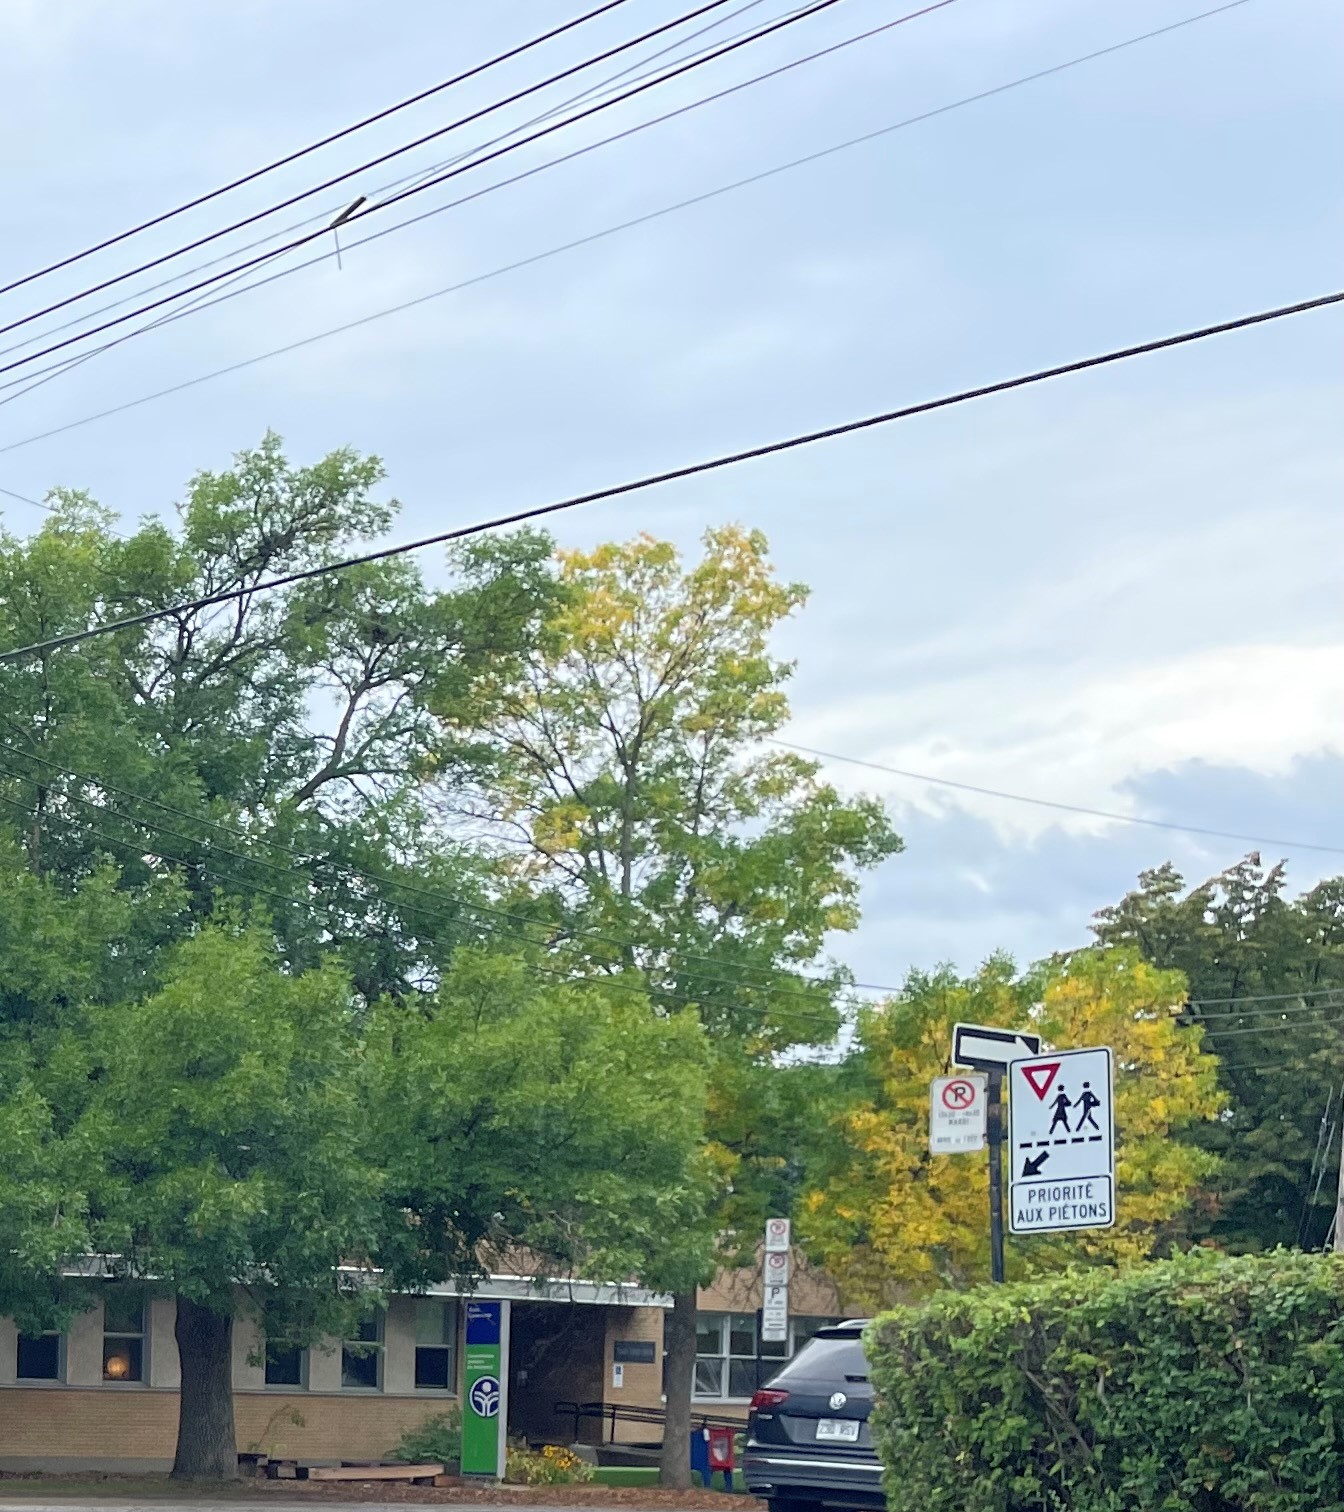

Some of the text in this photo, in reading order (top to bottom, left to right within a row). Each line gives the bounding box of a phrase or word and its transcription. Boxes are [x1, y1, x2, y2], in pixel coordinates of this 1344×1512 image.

[1028, 1182, 1094, 1204] PRIORITÉ
[1017, 1203, 1107, 1224] AUX PIÉTONS
